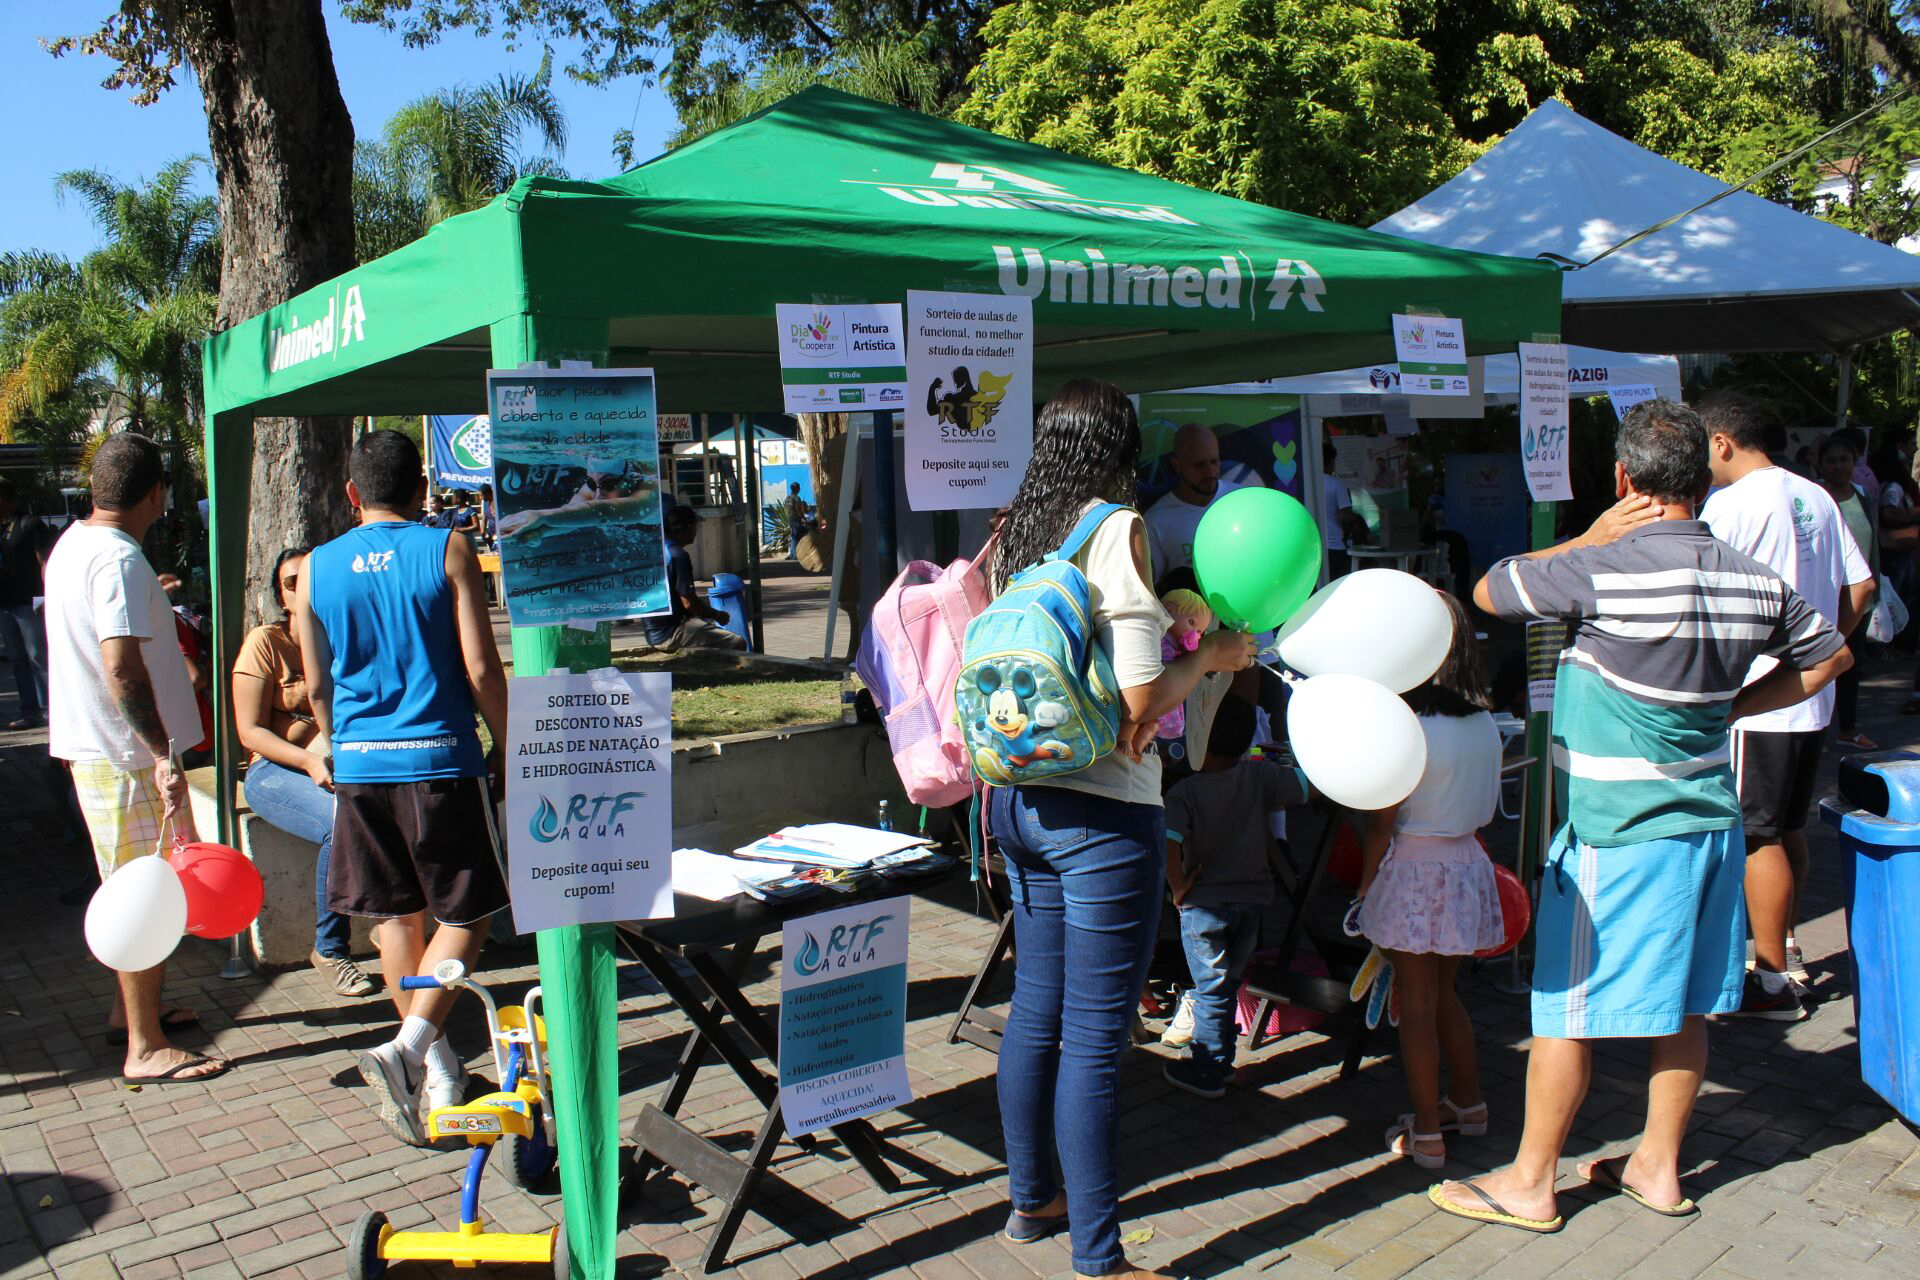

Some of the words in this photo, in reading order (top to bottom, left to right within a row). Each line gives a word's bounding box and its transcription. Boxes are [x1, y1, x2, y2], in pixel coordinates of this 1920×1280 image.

[992, 245, 1240, 309] Unimed
[926, 308, 961, 320] Sorteio
[964, 310, 976, 320] de
[978, 311, 1004, 322] aulas
[1006, 312, 1018, 322] de
[270, 296, 334, 373] Unimed
[791, 324, 809, 337] Dia
[852, 323, 889, 334] Pintura
[920, 325, 970, 339] funcional,
[975, 330, 987, 339] no
[989, 330, 1023, 340] melhor
[799, 339, 835, 352] Cooperar
[853, 339, 896, 351] Artística
[928, 345, 959, 356] studio
[961, 346, 974, 356] da
[976, 346, 1014, 357] cidade!!
[828, 371, 840, 379] RTF
[841, 371, 861, 379] Studio
[524, 385, 566, 398] Maior
[574, 385, 623, 402] piscina
[1634, 387, 1651, 397] HUNT
[501, 409, 563, 423] coberta
[569, 412, 579, 421] e
[584, 406, 647, 425] aquecida
[938, 401, 1002, 425] RTF
[541, 432, 559, 446] da
[565, 430, 611, 445] cidade
[940, 426, 996, 437] Studio
[1537, 425, 1567, 450] RTF
[1534, 450, 1561, 460] AQUA
[922, 459, 966, 472] Deposite
[968, 459, 990, 471] aqui
[992, 459, 1009, 468] seu
[949, 476, 987, 488] cupom!
[368, 550, 395, 566] RTF
[518, 555, 577, 576] Agende
[511, 577, 615, 603] experimental
[548, 694, 607, 708] SORTEIO
[611, 693, 630, 706] DE
[535, 717, 610, 732] DESCONTO
[614, 715, 643, 728] NAS
[518, 740, 564, 756] AULAS
[567, 740, 586, 752] DE
[589, 735, 660, 753] NATAÇÃO
[522, 766, 531, 779] E
[534, 758, 656, 778] HIDROGINÁSTICA
[565, 791, 648, 827] RTF
[560, 823, 625, 841] AQUA
[531, 862, 588, 880] Deposite
[591, 859, 623, 876] aqui
[626, 858, 650, 871] seu
[564, 882, 615, 899] cupom!
[826, 914, 896, 957] RTF
[821, 947, 875, 972] AQUA
[795, 981, 865, 1006] Hidroginástica
[794, 1007, 833, 1023] Natação
[834, 1002, 855, 1014] para
[793, 1025, 832, 1040] Natação
[833, 1019, 855, 1033] para
[857, 1011, 882, 1023] todas
[883, 1008, 894, 1017] as
[817, 1038, 849, 1052] idades
[792, 1053, 855, 1077] Hidroterapia
[795, 1075, 838, 1095] PISCINA
[838, 1061, 884, 1082] COBERTA
[820, 1083, 875, 1107] AQUECIDA!
[798, 1093, 897, 1129] #mergulhenessaideia
